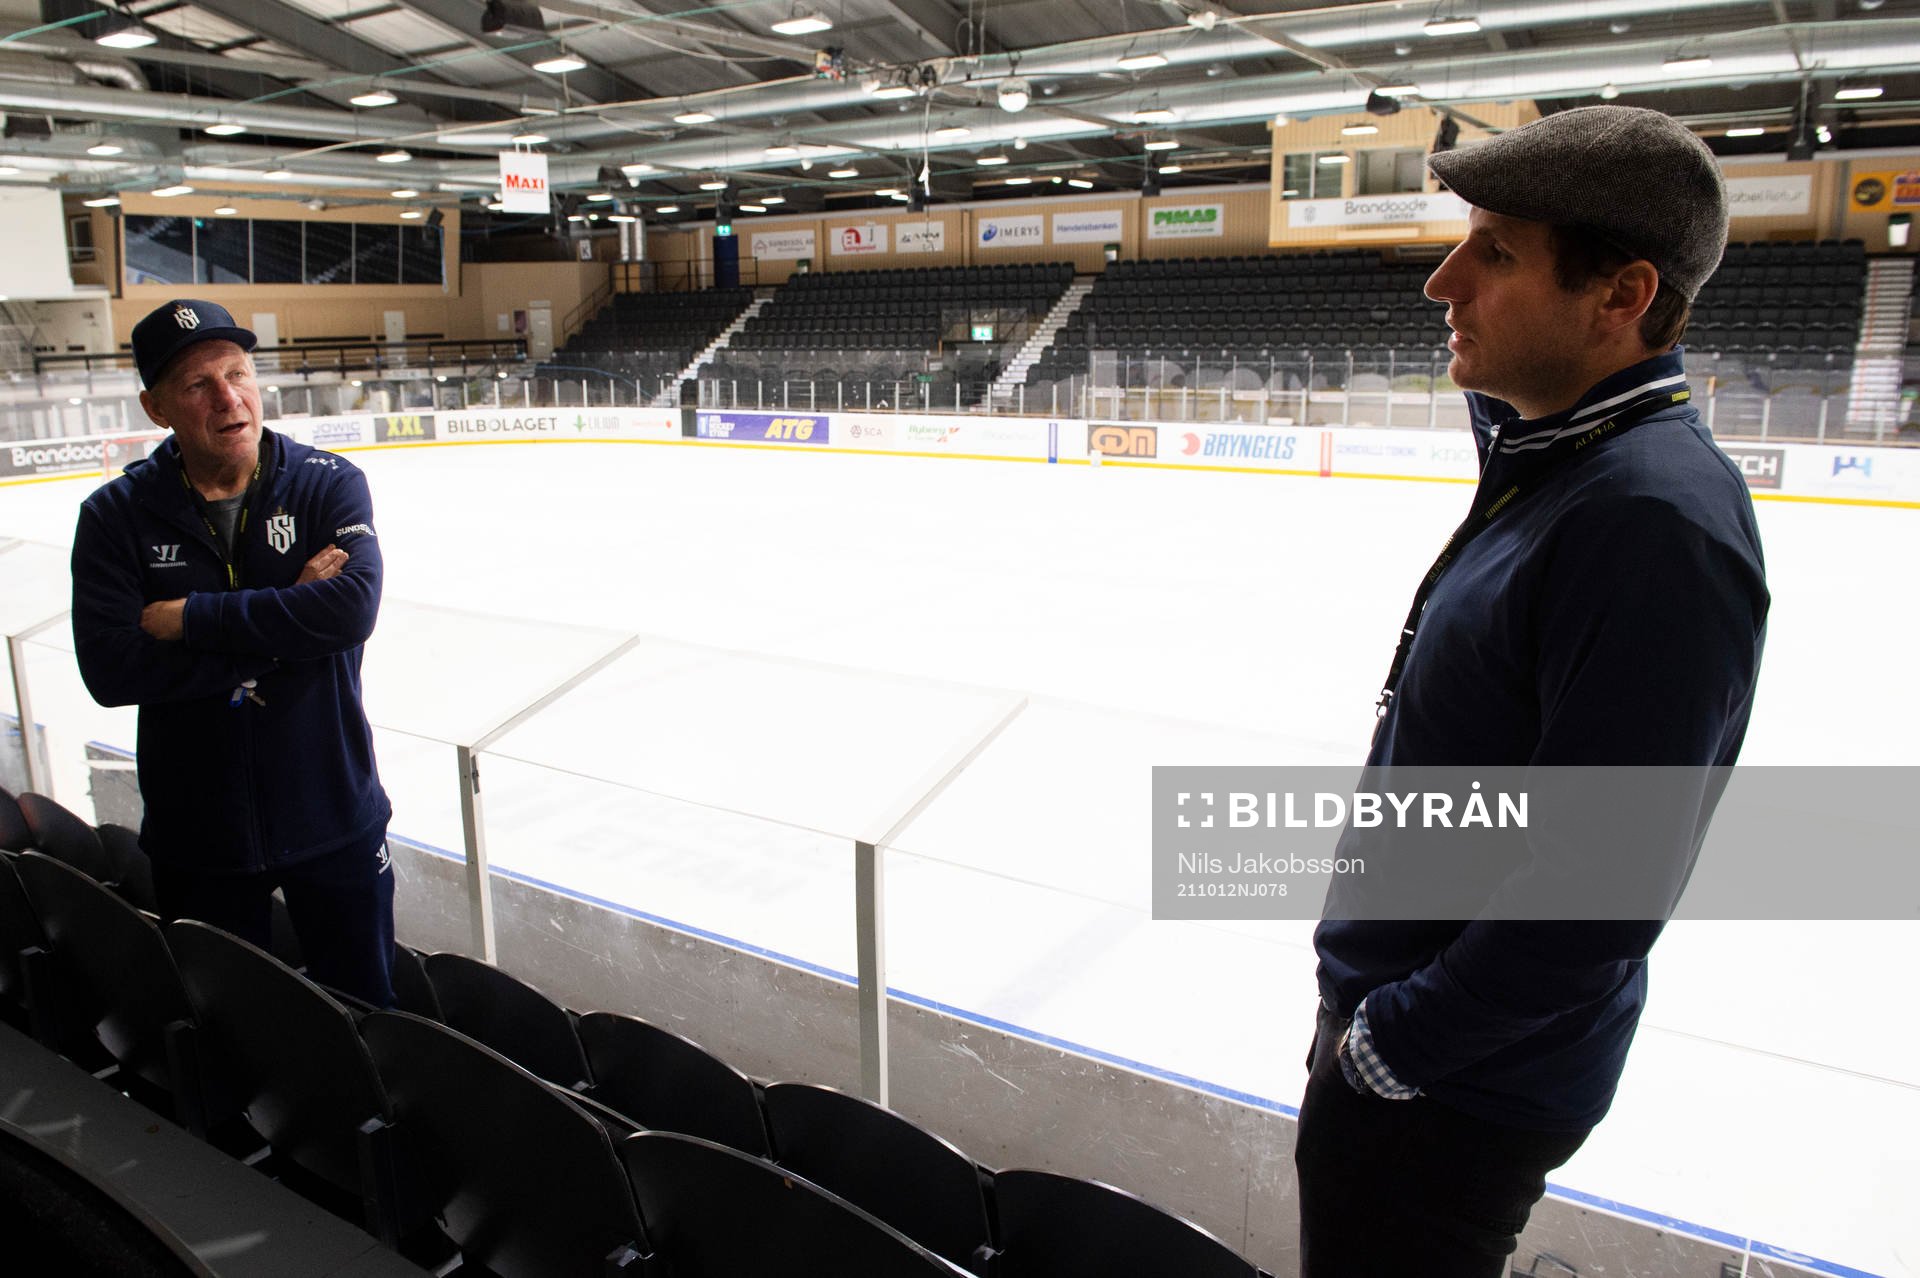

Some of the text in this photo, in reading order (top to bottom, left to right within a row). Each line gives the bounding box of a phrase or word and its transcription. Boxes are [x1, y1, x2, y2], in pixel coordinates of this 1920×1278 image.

[1000, 226, 1040, 238] IMERYS
[1057, 222, 1118, 233] Handelsbanken
[312, 421, 360, 434] JOWIC
[387, 415, 424, 437] XXL
[447, 416, 557, 433] BILBOLAGET
[764, 418, 816, 440] ATG
[863, 427, 884, 437] SCA
[1203, 433, 1296, 460] BRYNGELS
